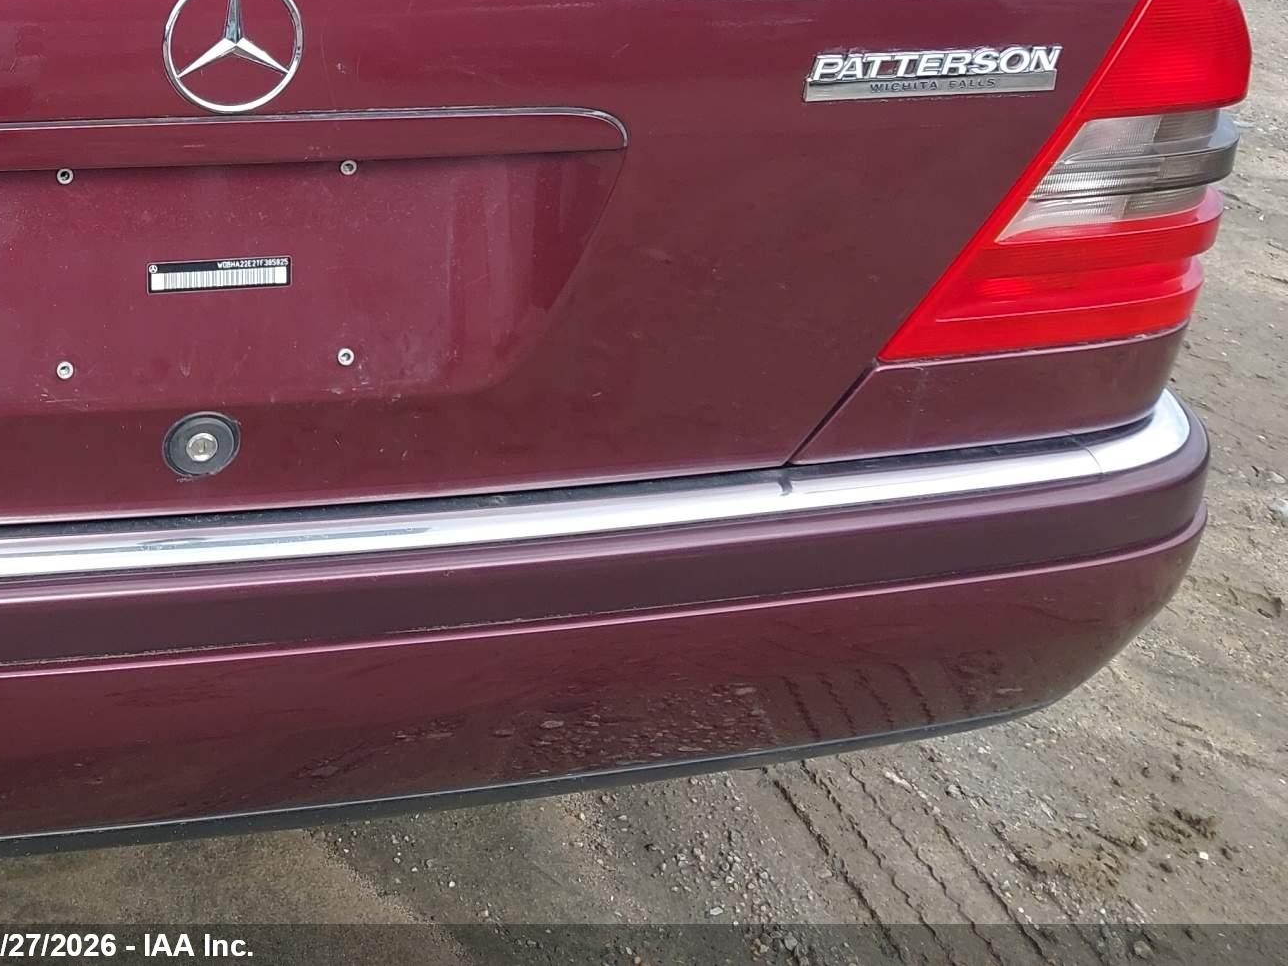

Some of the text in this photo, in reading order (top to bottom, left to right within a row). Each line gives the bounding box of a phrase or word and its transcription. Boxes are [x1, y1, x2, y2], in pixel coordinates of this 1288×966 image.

[811, 45, 1063, 82] PATTERSON
[869, 77, 996, 94] WICHITA FALLS
